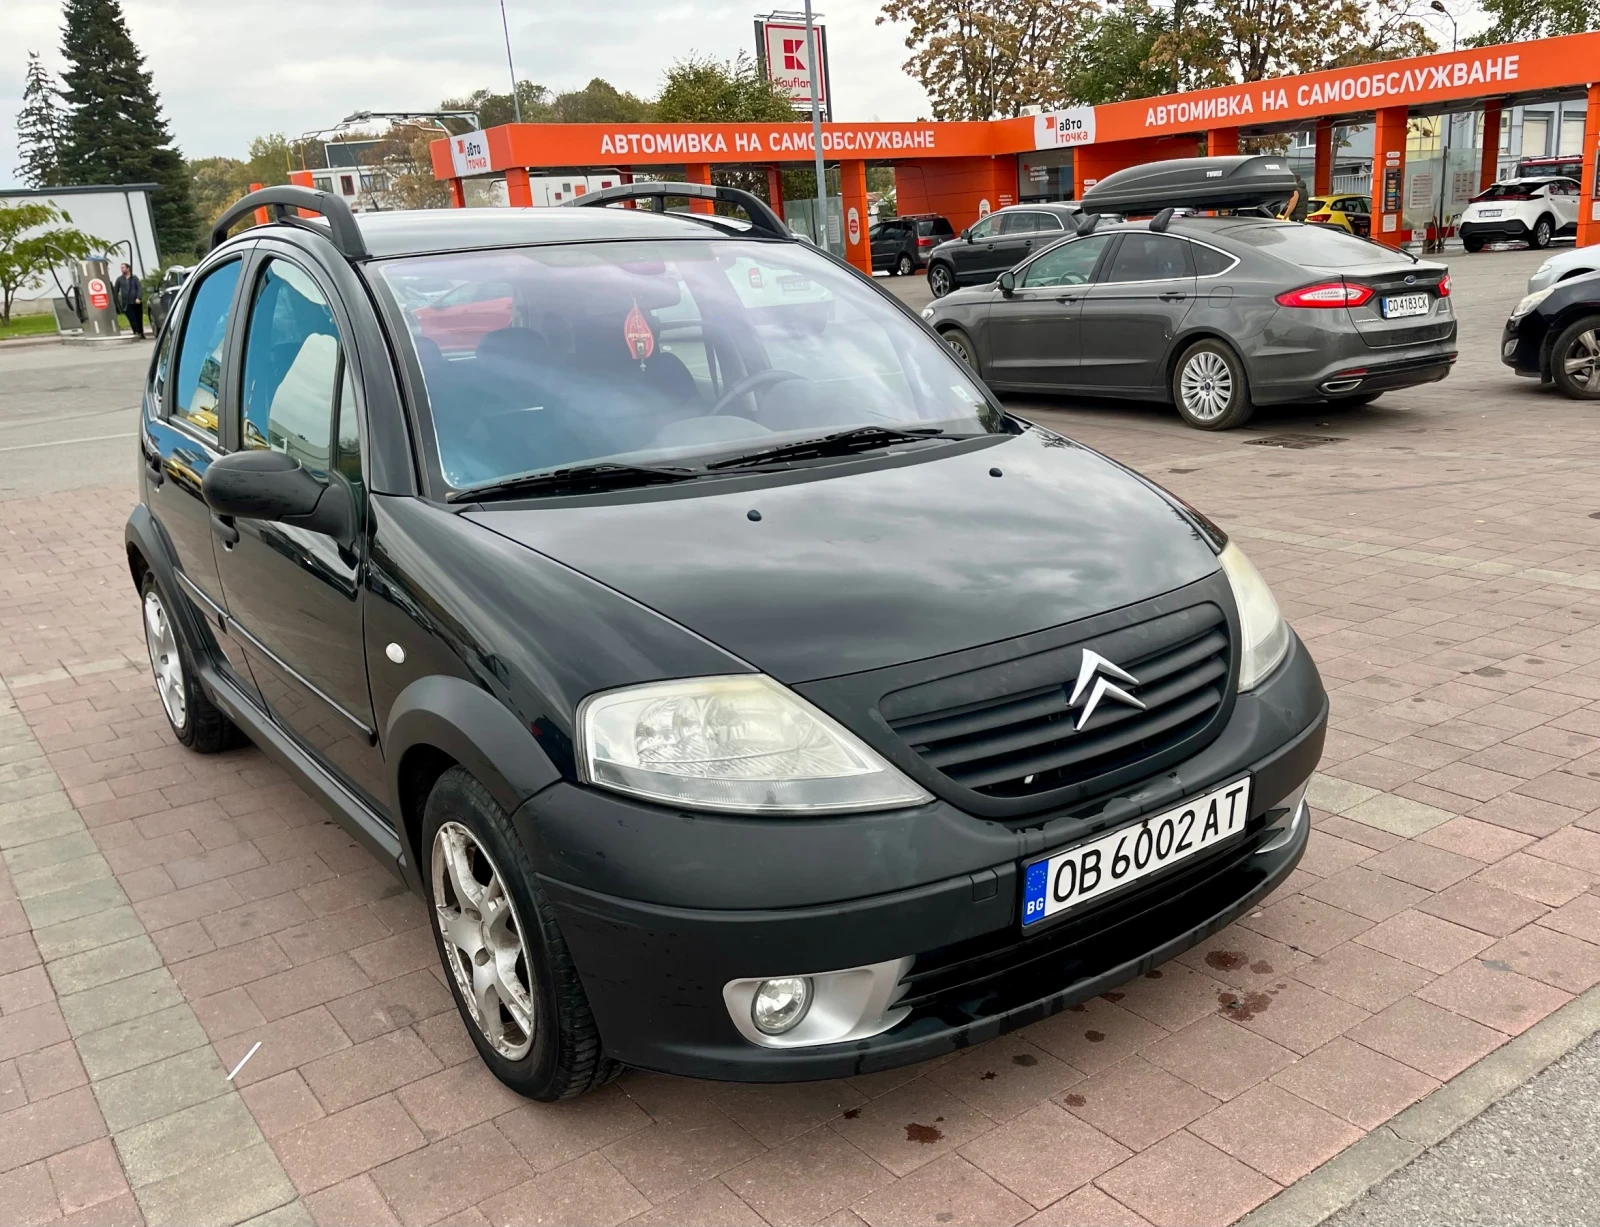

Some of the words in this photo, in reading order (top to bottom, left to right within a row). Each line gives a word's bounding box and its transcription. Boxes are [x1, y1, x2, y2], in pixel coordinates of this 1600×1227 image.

[775, 77, 812, 88] Kauflan
[1145, 94, 1253, 127] АВТОМИВКА
[1262, 88, 1288, 111] НА
[1297, 55, 1520, 107] САМООБСЛУЖВАНЕ
[1059, 118, 1082, 131] авто
[601, 133, 728, 154] АВТОМИВКА
[735, 133, 762, 152] НА
[769, 130, 935, 151] САМООБСЛУЖВАНЕ
[1059, 131, 1088, 143] точка
[468, 157, 487, 169] точка
[1053, 848, 1102, 903] OB
[1111, 809, 1196, 879] 6002
[1201, 786, 1244, 842] AT
[1026, 897, 1044, 915] BG
